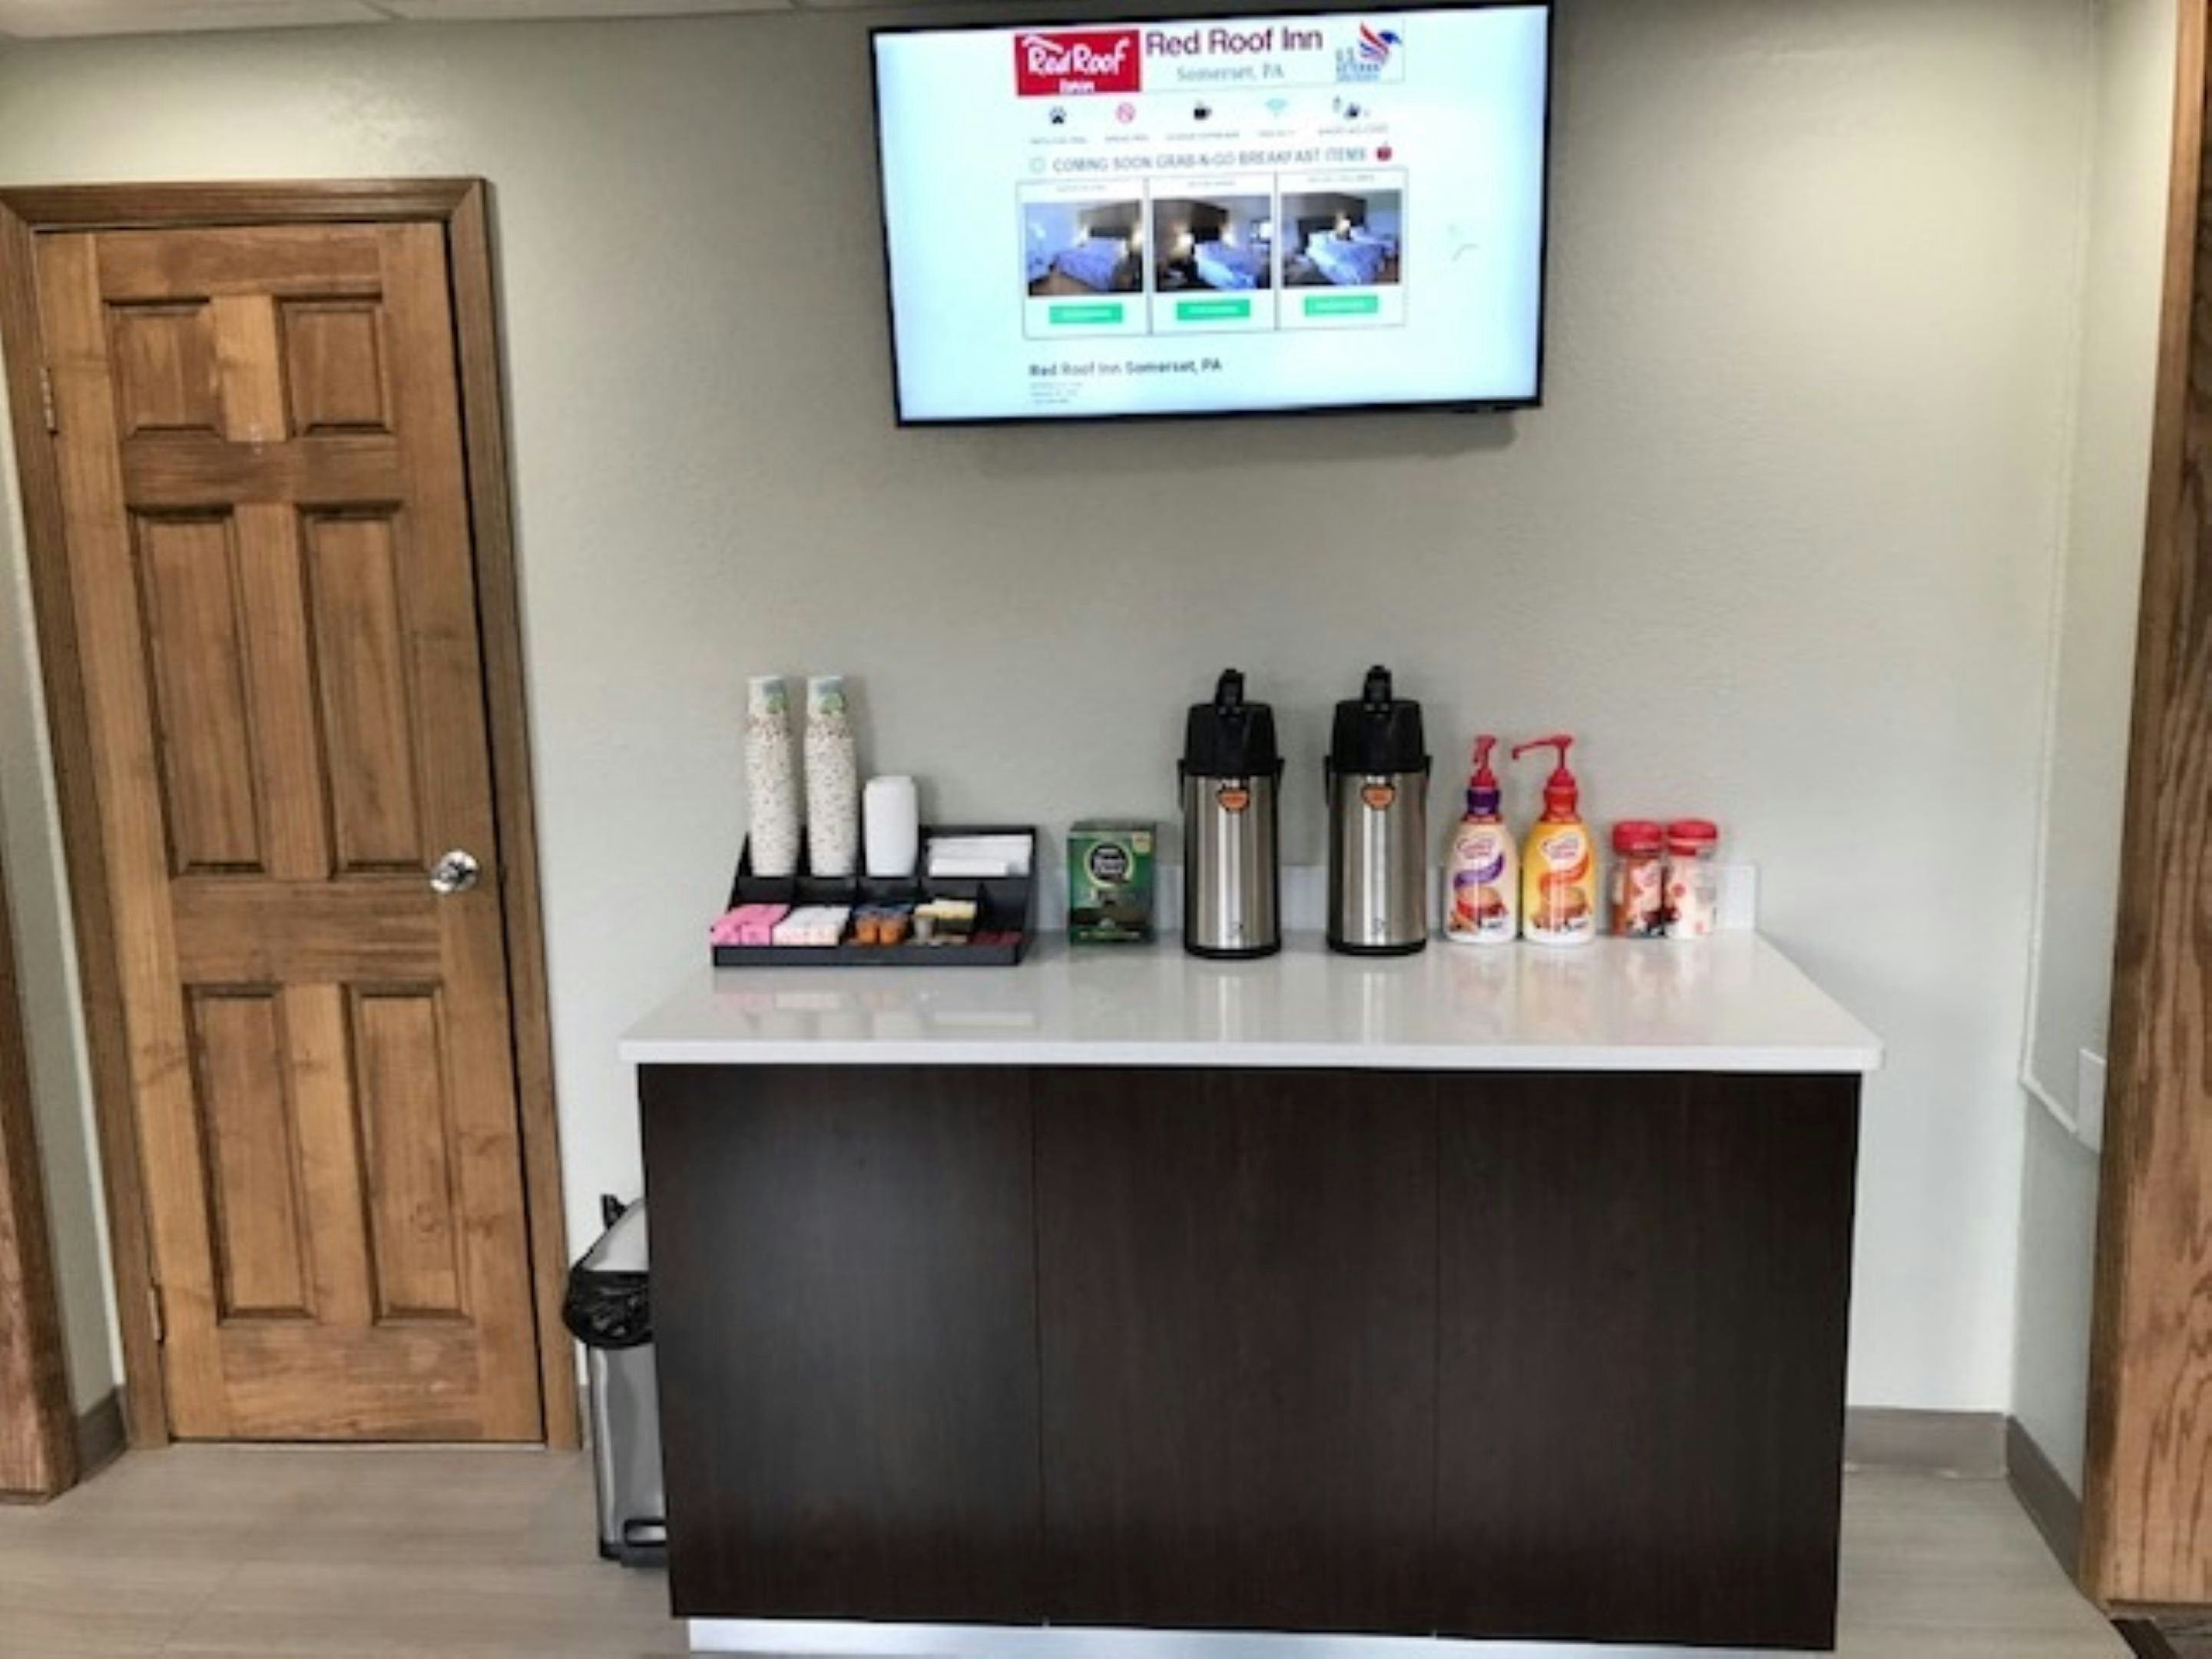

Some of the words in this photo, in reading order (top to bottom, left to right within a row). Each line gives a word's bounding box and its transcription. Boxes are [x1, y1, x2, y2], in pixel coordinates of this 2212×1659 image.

[1146, 29, 1200, 56] Red
[1208, 27, 1273, 55] Roof
[1282, 25, 1323, 51] Inn
[1026, 45, 1071, 75] Red
[1072, 37, 1131, 75] Roof
[1052, 157, 1109, 173] COMING
[1114, 155, 1152, 171] SOON
[1325, 146, 1366, 162] ITEMS
[1029, 362, 1057, 376] Red
[1061, 361, 1095, 376] Roof
[1098, 362, 1122, 375] Inn
[1201, 356, 1222, 372] PA
